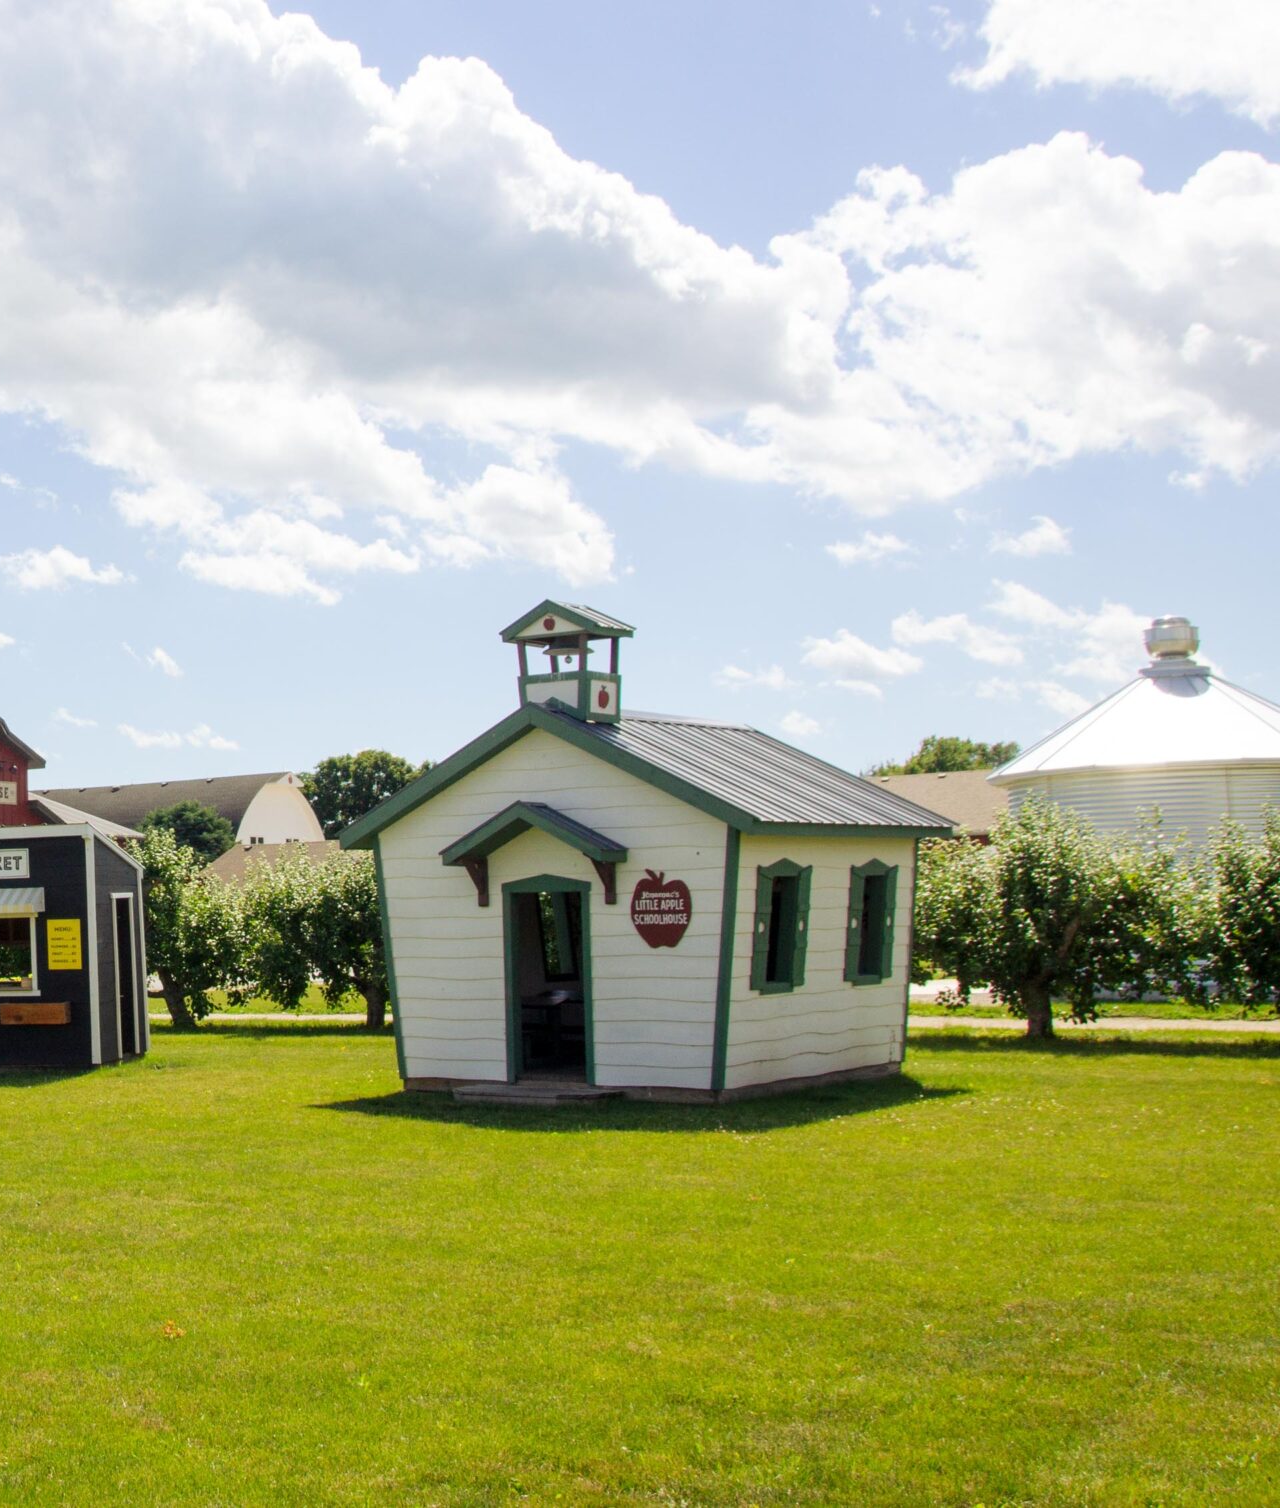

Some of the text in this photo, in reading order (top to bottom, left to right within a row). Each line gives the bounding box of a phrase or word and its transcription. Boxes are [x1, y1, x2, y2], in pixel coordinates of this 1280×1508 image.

[635, 898, 685, 911] LITTLE APPLE
[634, 913, 688, 925] SCHOOLHOUSE
